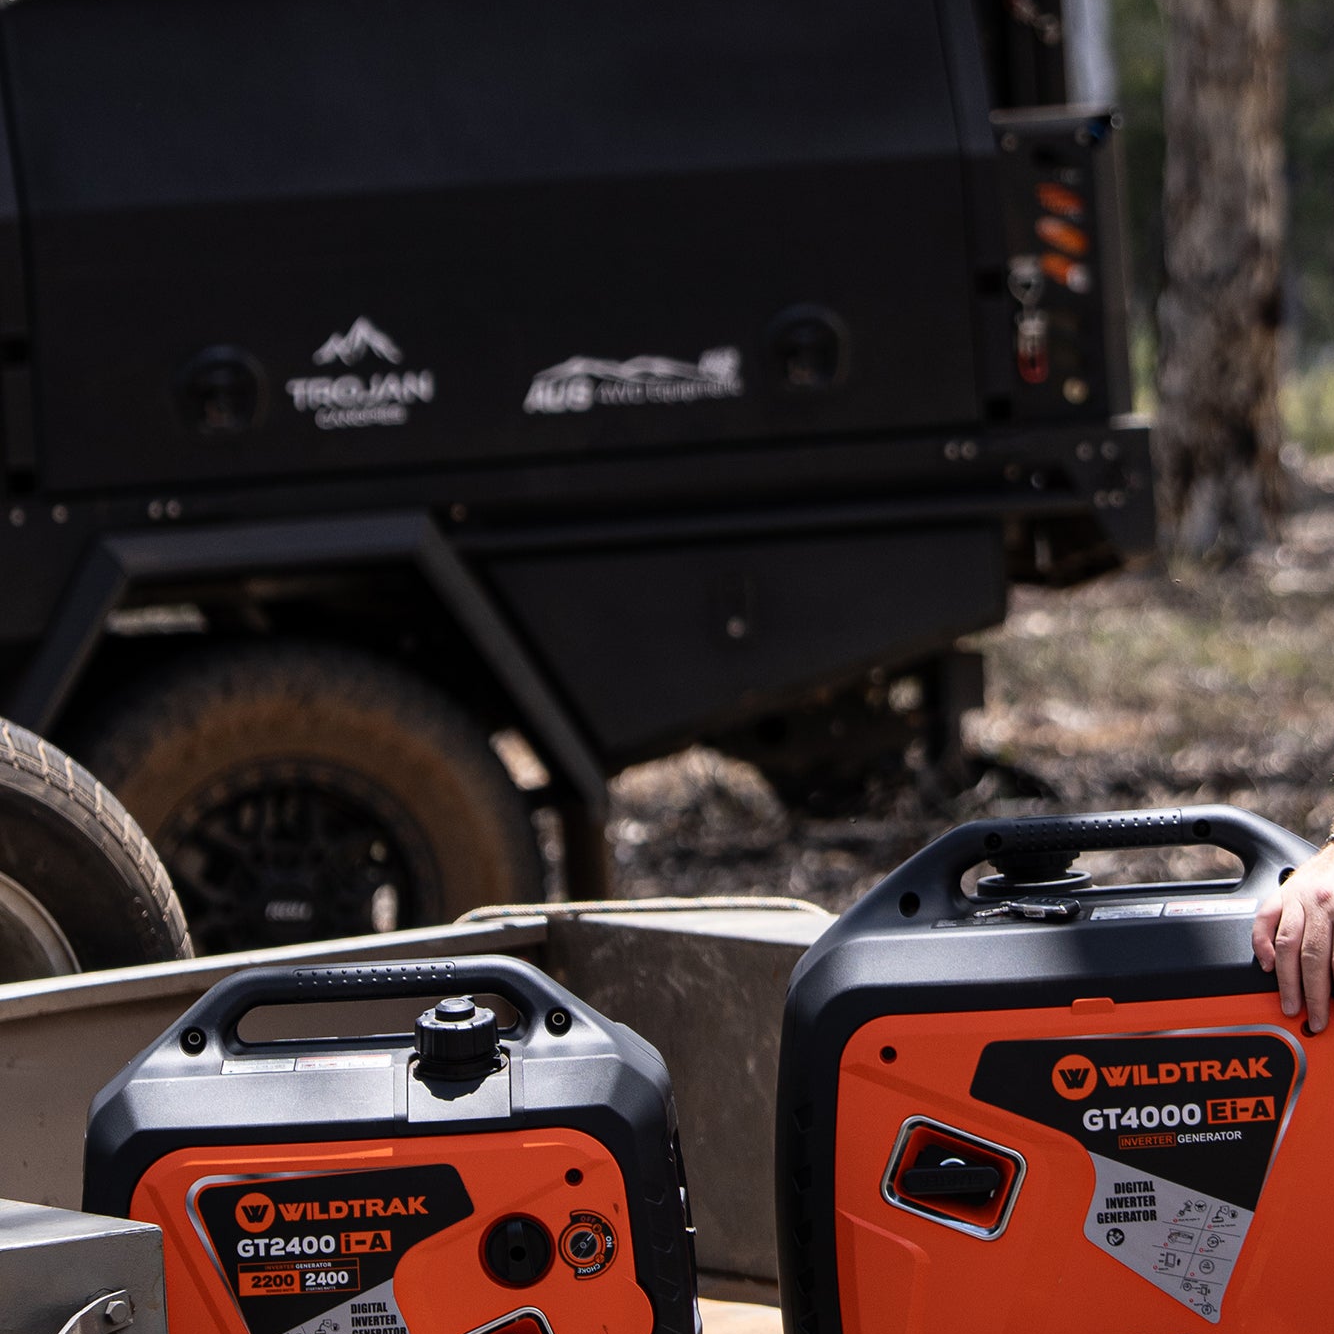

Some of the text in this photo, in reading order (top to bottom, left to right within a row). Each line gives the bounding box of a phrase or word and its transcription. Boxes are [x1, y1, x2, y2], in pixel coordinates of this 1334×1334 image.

[286, 370, 434, 411] TROJAN
[1100, 1057, 1272, 1088] WILDTRAK
[1082, 1099, 1271, 1131] GT4000 Ei-A
[1121, 1130, 1242, 1147] INVERTER GENERATOR
[1114, 1180, 1155, 1194] DIGITAL
[278, 1196, 429, 1221] WILDTRAK
[1105, 1195, 1156, 1208] INVERTER
[1097, 1209, 1157, 1224] GENERATOR
[237, 1233, 387, 1258] GT2400 i-A
[606, 1236, 613, 1248] ON
[295, 1262, 332, 1270] GENERATOR
[577, 1263, 601, 1274] CHOKE
[251, 1271, 349, 1289] 2200 2400
[351, 1302, 387, 1314] DIGITAL
[351, 1314, 397, 1327] INVERTER
